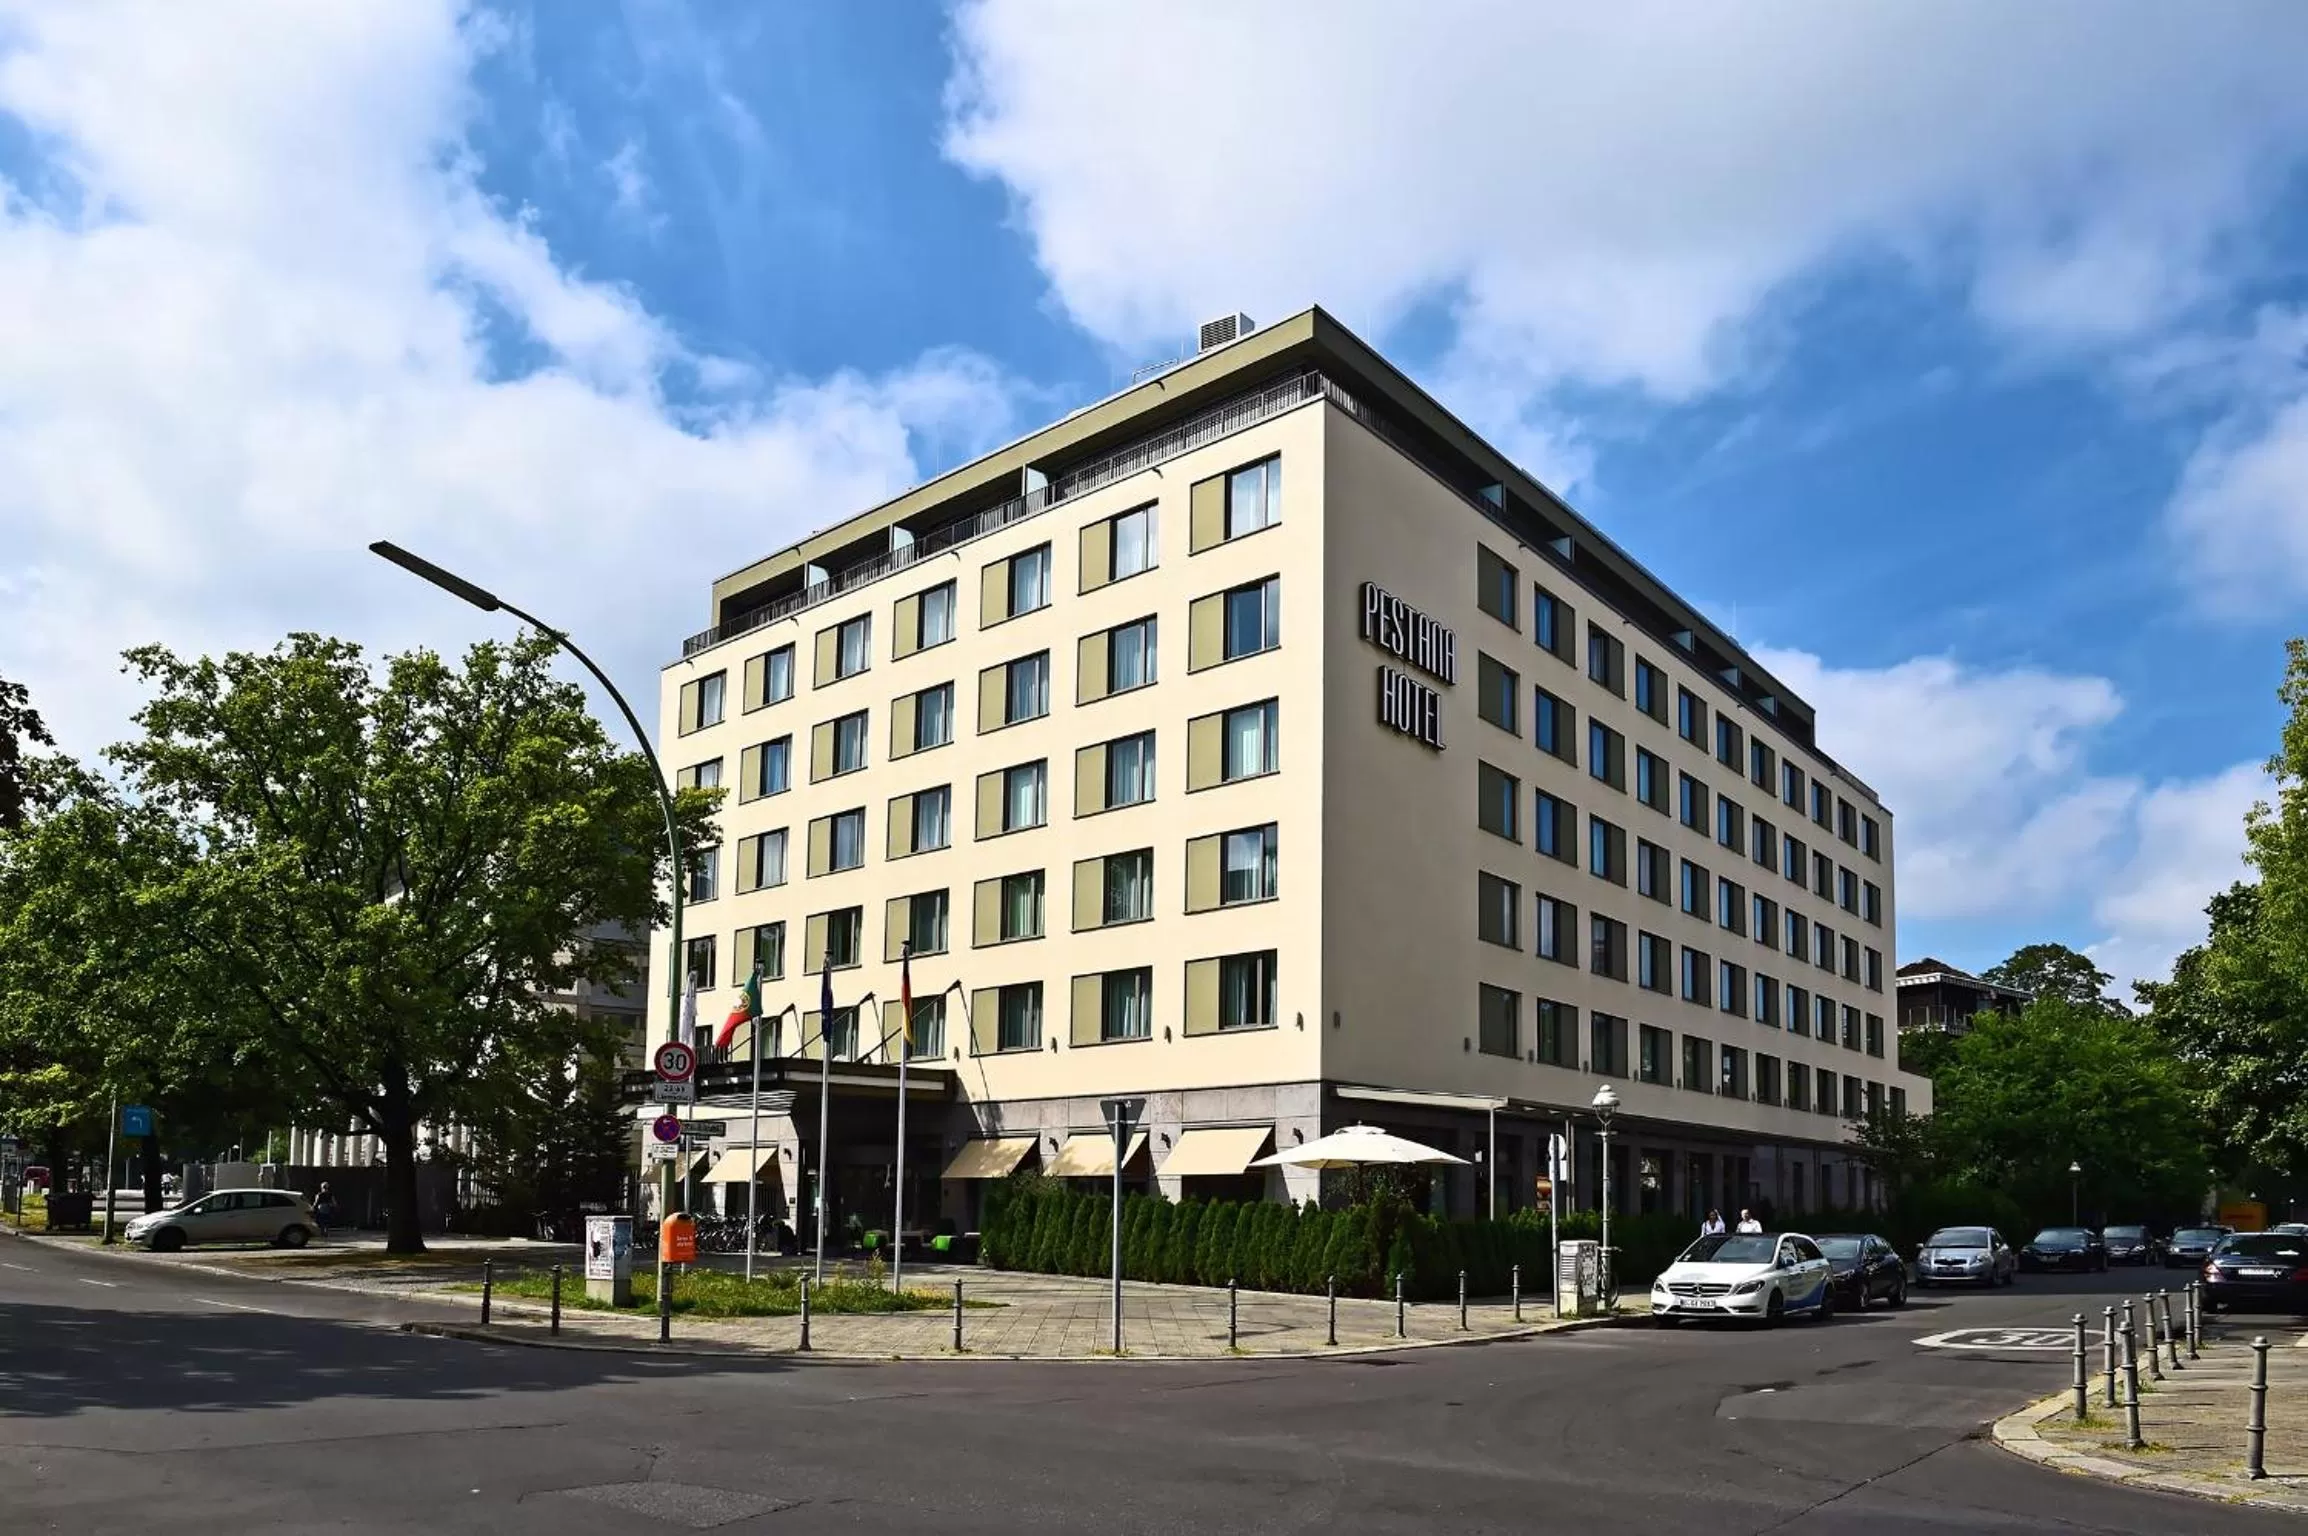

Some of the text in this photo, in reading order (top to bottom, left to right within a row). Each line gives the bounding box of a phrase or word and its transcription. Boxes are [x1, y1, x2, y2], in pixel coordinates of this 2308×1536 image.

[1360, 582, 1456, 685] PESTANA
[1380, 665, 1446, 750] HOTEL
[663, 1052, 687, 1071] 30
[1971, 1329, 2076, 1346] 30
